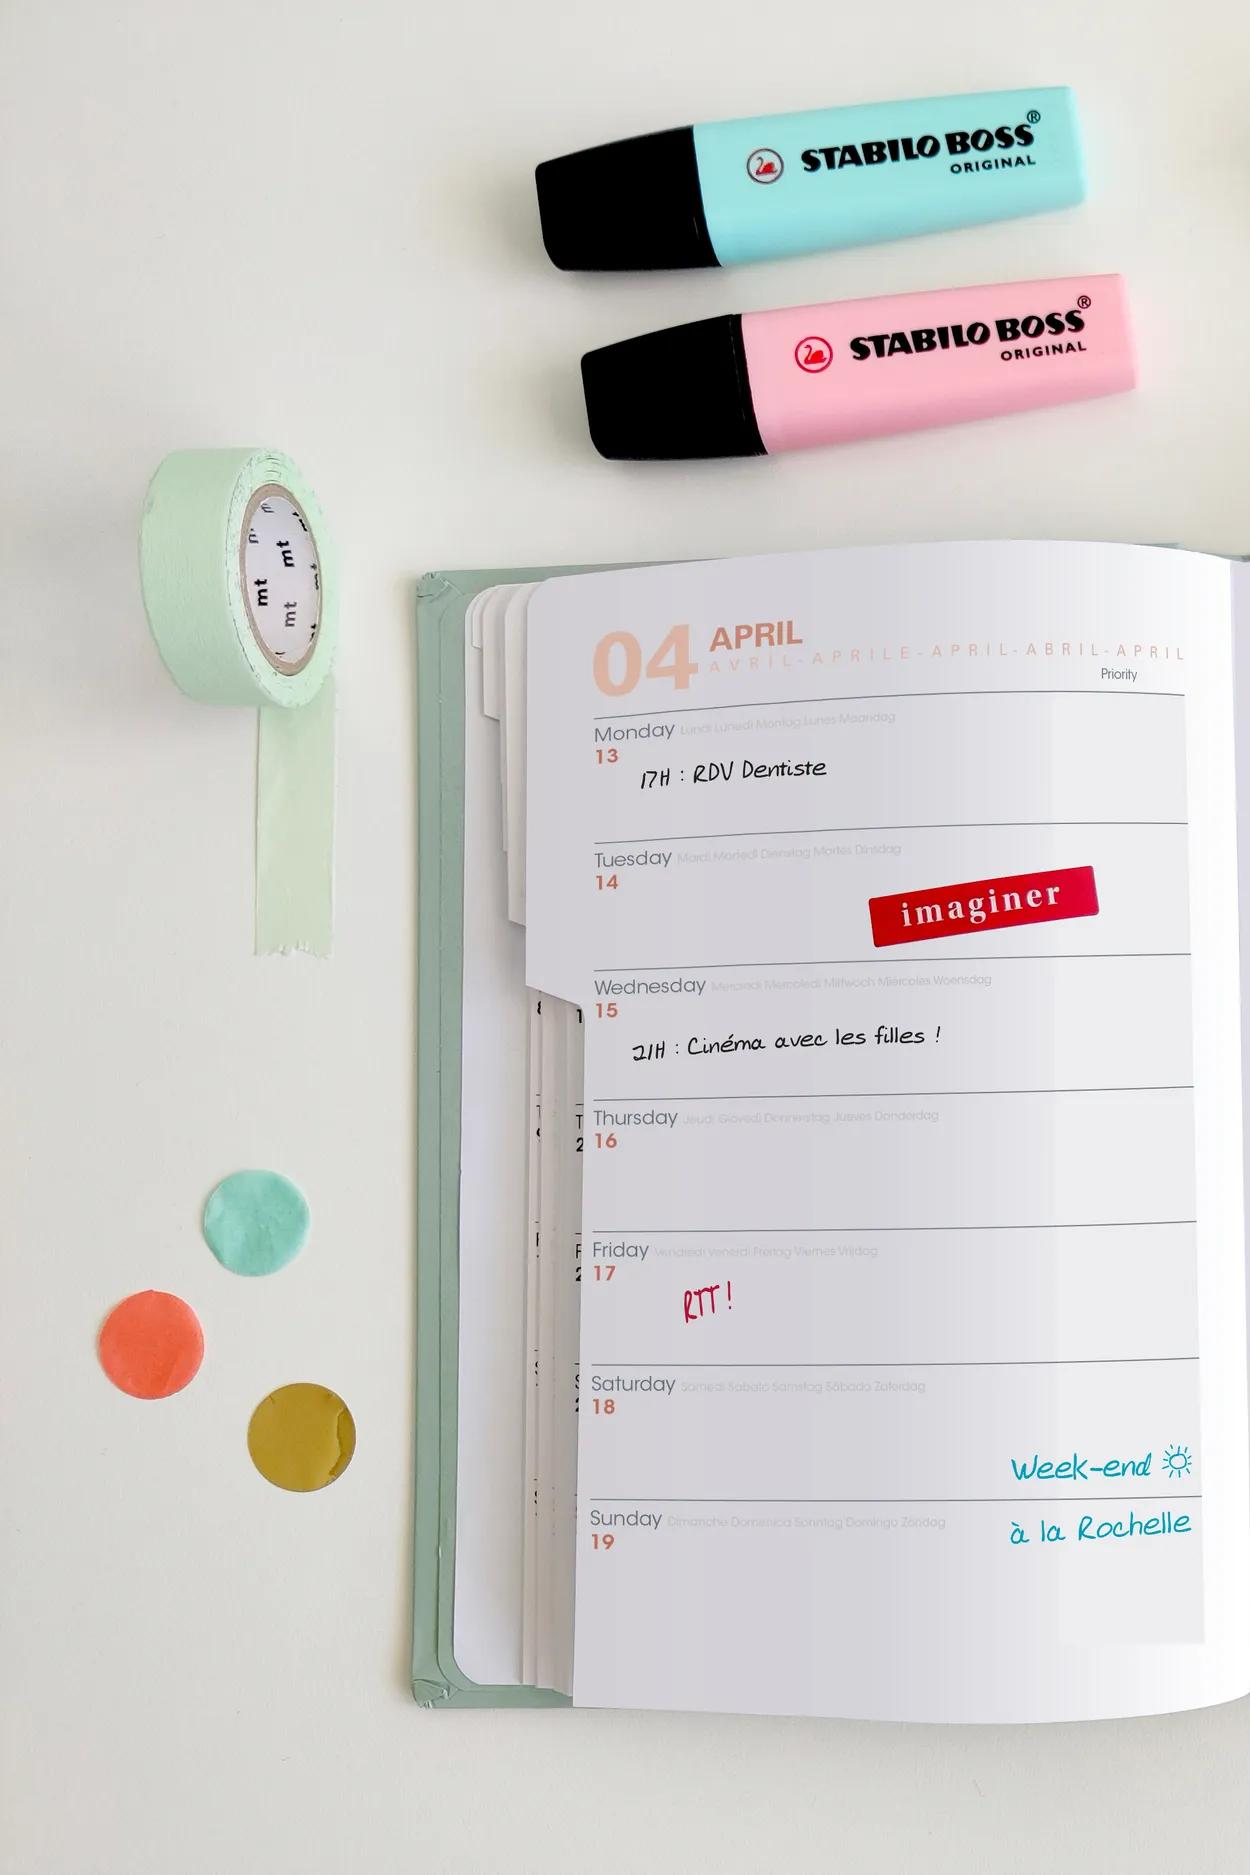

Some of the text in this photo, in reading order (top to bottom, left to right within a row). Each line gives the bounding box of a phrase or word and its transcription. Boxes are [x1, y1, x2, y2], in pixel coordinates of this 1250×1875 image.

[801, 135, 939, 172] STABILO
[949, 155, 1036, 174] ORIGINAL
[850, 322, 990, 361] STABILO
[1000, 341, 1087, 362] ORIGINAL
[254, 578, 268, 607] mt
[709, 620, 804, 652] APRIL
[593, 624, 698, 697] 04
[1101, 667, 1138, 682] Priority
[594, 722, 675, 742] Monday
[595, 749, 619, 764] 13
[640, 769, 670, 789] 17H
[693, 762, 734, 785] RDV
[743, 759, 827, 780] Dentiste
[594, 851, 672, 871] Tuesday
[596, 875, 619, 890] 14
[900, 883, 1061, 928] imaginer
[594, 978, 706, 997] Wednesday
[595, 1003, 618, 1018] 15
[687, 1034, 766, 1057] Cinéma
[775, 1033, 829, 1049] avec
[835, 1028, 867, 1046] les
[875, 1025, 925, 1045] filles
[593, 1110, 678, 1128] Thursday
[594, 1133, 618, 1149] 16
[592, 1241, 649, 1261] Friday
[593, 1265, 616, 1281] 17
[591, 1376, 675, 1395] Saturday
[592, 1398, 615, 1415] 18
[1011, 1452, 1152, 1480] Week-end
[590, 1510, 662, 1530] Sunday
[1010, 1511, 1192, 1544] à la Rochelle
[591, 1533, 614, 1550] 19
